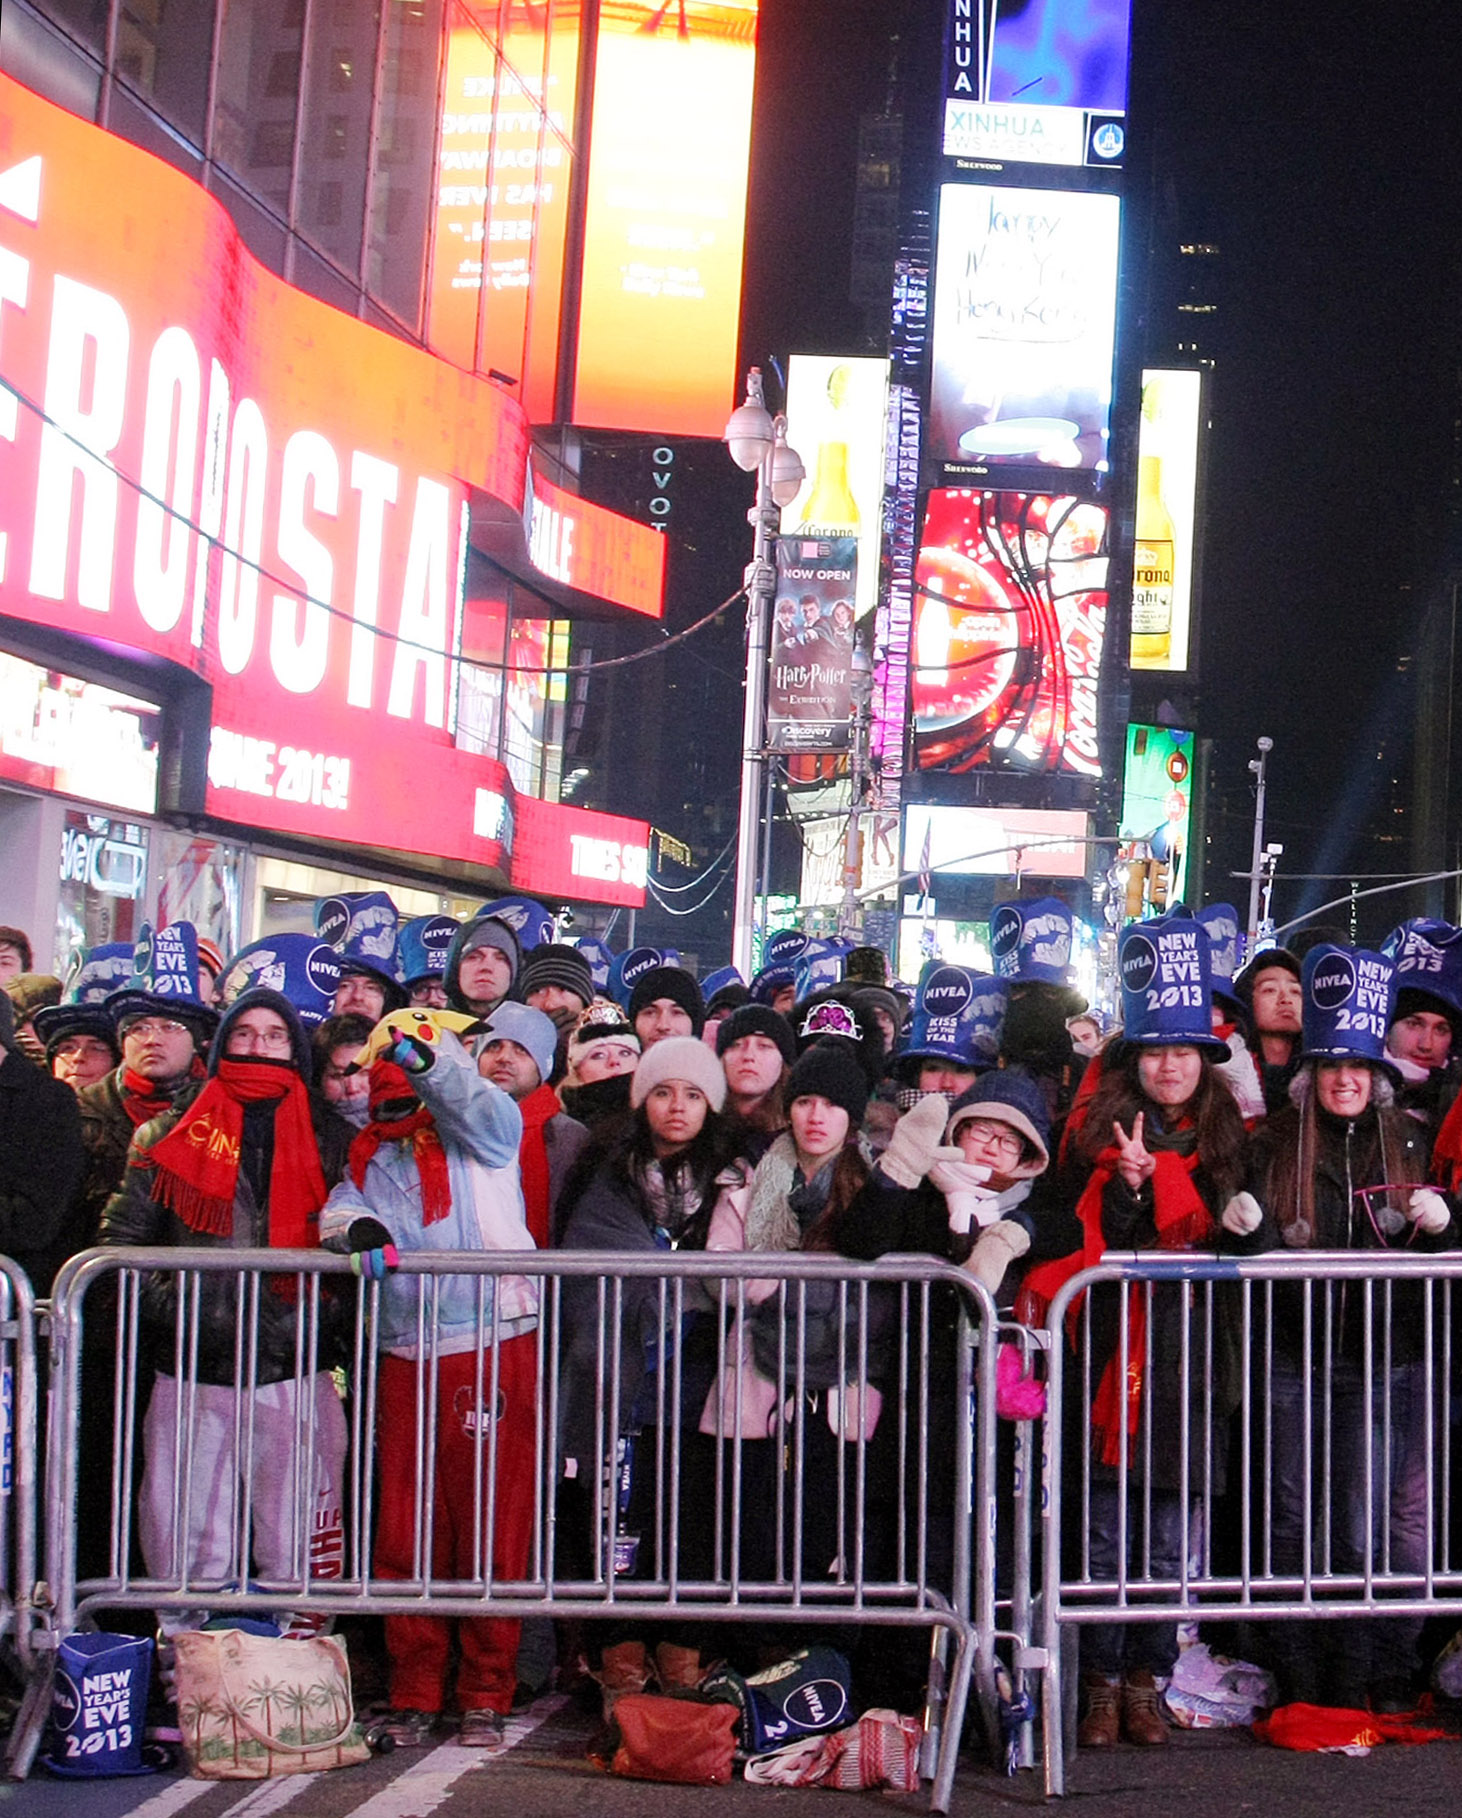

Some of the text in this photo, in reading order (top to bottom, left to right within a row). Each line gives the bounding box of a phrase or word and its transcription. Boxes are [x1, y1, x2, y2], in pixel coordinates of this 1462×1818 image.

[950, 111, 1044, 136] XINHUA
[783, 568, 851, 581] NOW OPEN
[775, 662, 847, 693] Harry Potter
[275, 746, 351, 811] 2013!
[771, 937, 805, 956] NIVEA
[1158, 932, 1197, 951] NEW
[156, 952, 188, 972] EVE
[1123, 954, 1153, 974] NIVEA
[1160, 950, 1199, 963] YEAR'S
[624, 960, 658, 980] NIVEA
[1161, 962, 1202, 983] EVE
[1357, 959, 1393, 983] NEW
[1315, 974, 1352, 990] NIVEA
[1358, 976, 1389, 995] YEAR'S
[926, 986, 968, 1000] NIVEA
[1146, 985, 1203, 1011] 2013
[1356, 990, 1388, 1014] EVE
[928, 1017, 958, 1027] KISS
[1335, 1008, 1386, 1039] 2013
[926, 1033, 957, 1044] YEAR
[622, 1463, 630, 1492] NIVEA
[83, 1669, 132, 1695] NEW
[84, 1687, 131, 1707] YEAR'S
[802, 1685, 826, 1723] NIVEA
[85, 1704, 131, 1729] EVE
[66, 1725, 133, 1758] 2013
